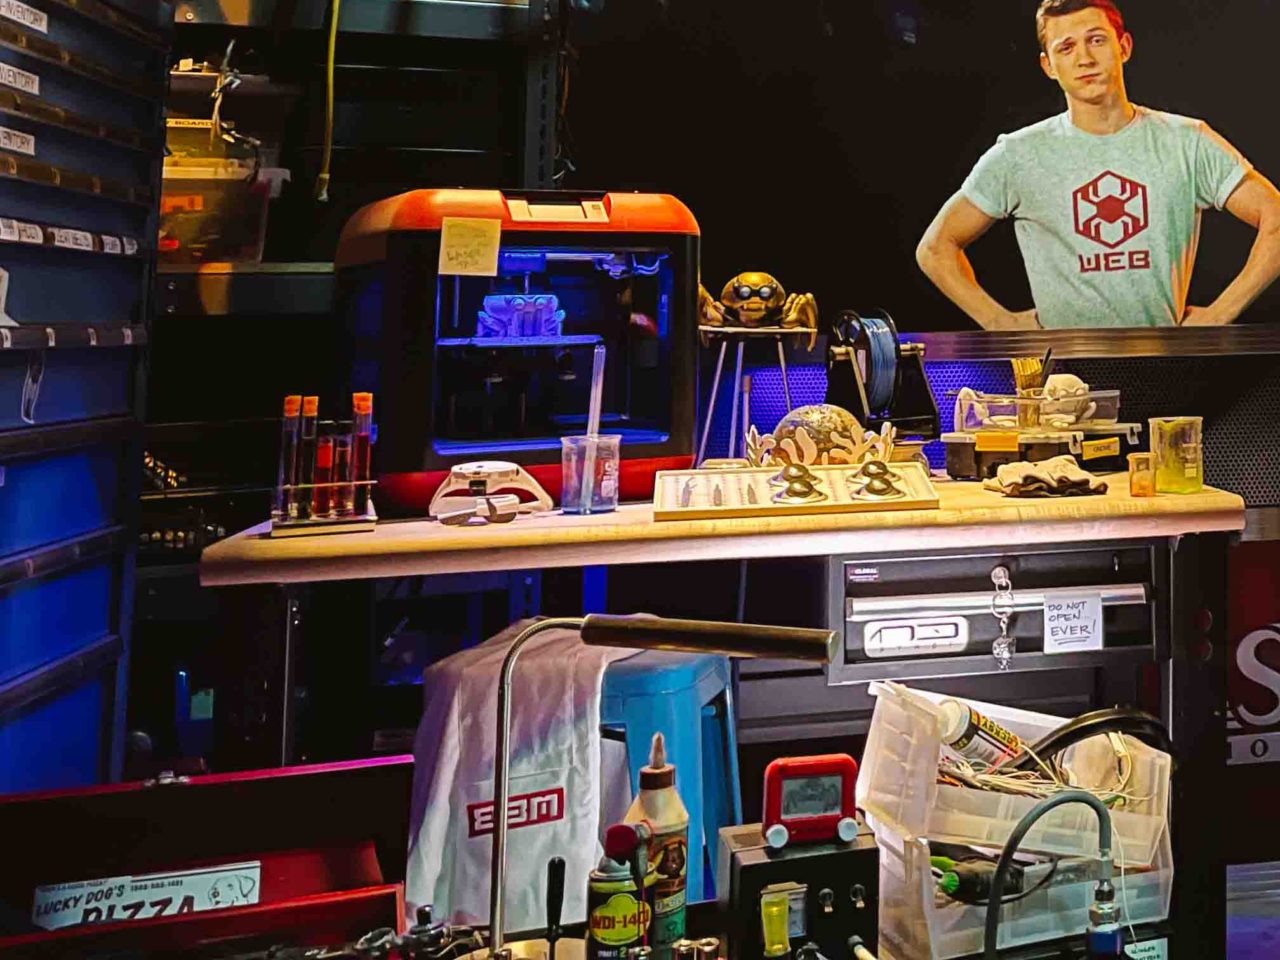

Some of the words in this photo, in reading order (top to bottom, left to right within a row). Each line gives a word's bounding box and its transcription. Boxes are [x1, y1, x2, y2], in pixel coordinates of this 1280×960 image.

[1078, 250, 1150, 273] WEB
[1048, 603, 1063, 612] DO
[1066, 600, 1088, 610] NOT
[1050, 618, 1097, 637] EVER!
[36, 893, 84, 918] LUCKY
[85, 884, 126, 905] DOG'S
